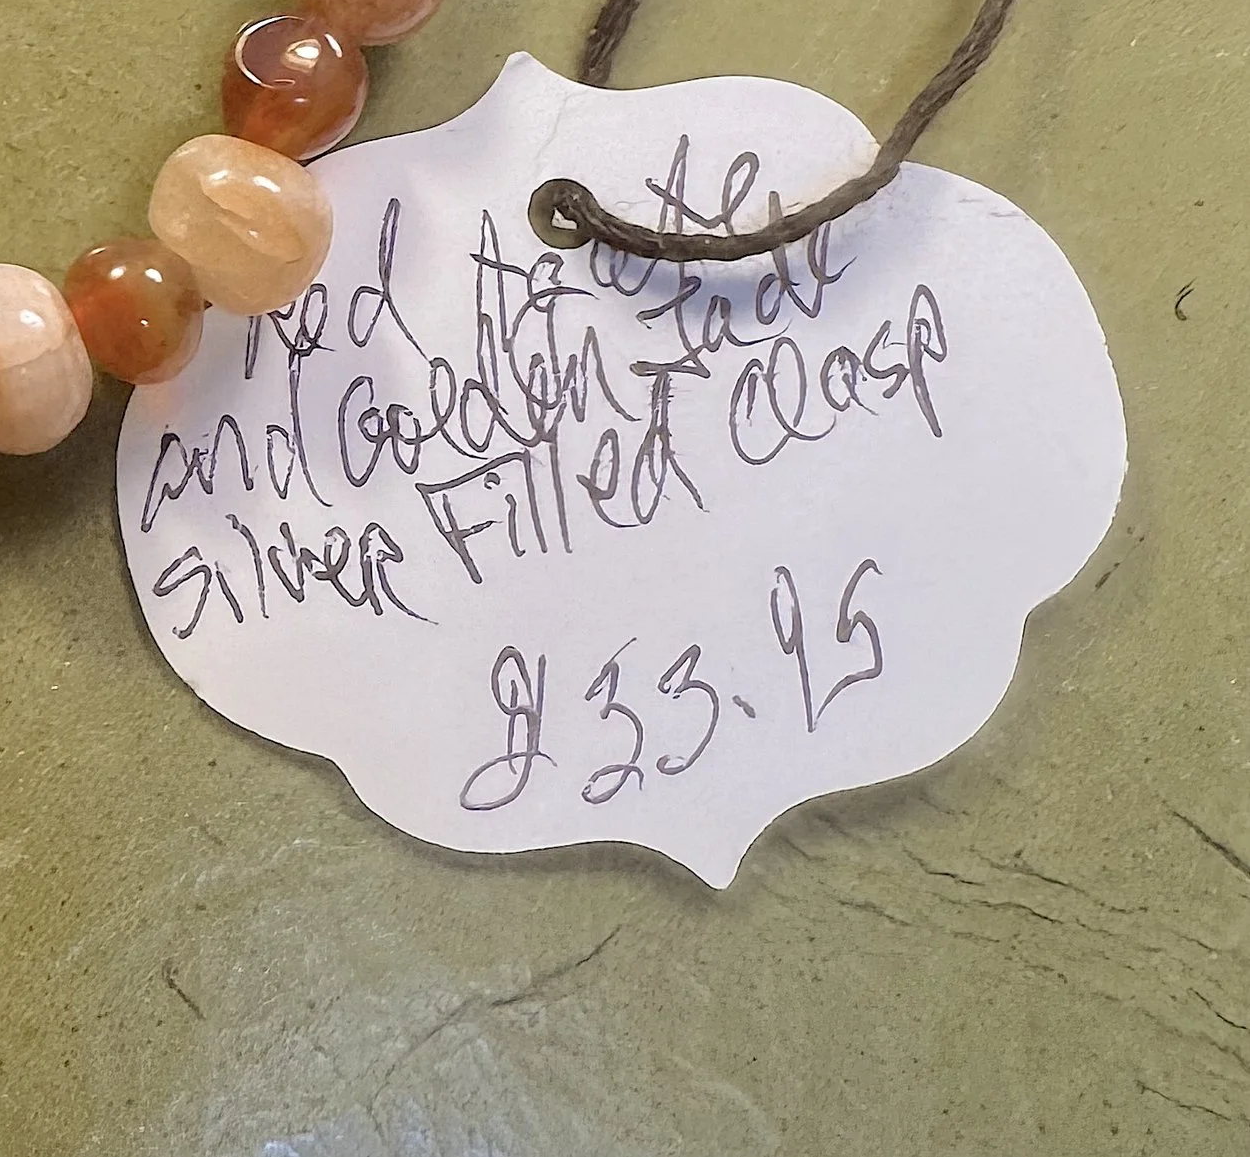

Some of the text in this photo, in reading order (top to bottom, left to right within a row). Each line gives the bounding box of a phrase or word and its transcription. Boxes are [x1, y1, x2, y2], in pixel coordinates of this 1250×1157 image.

[140, 349, 334, 533] and
[338, 314, 642, 489] Golden
[415, 370, 707, 585] Filled
